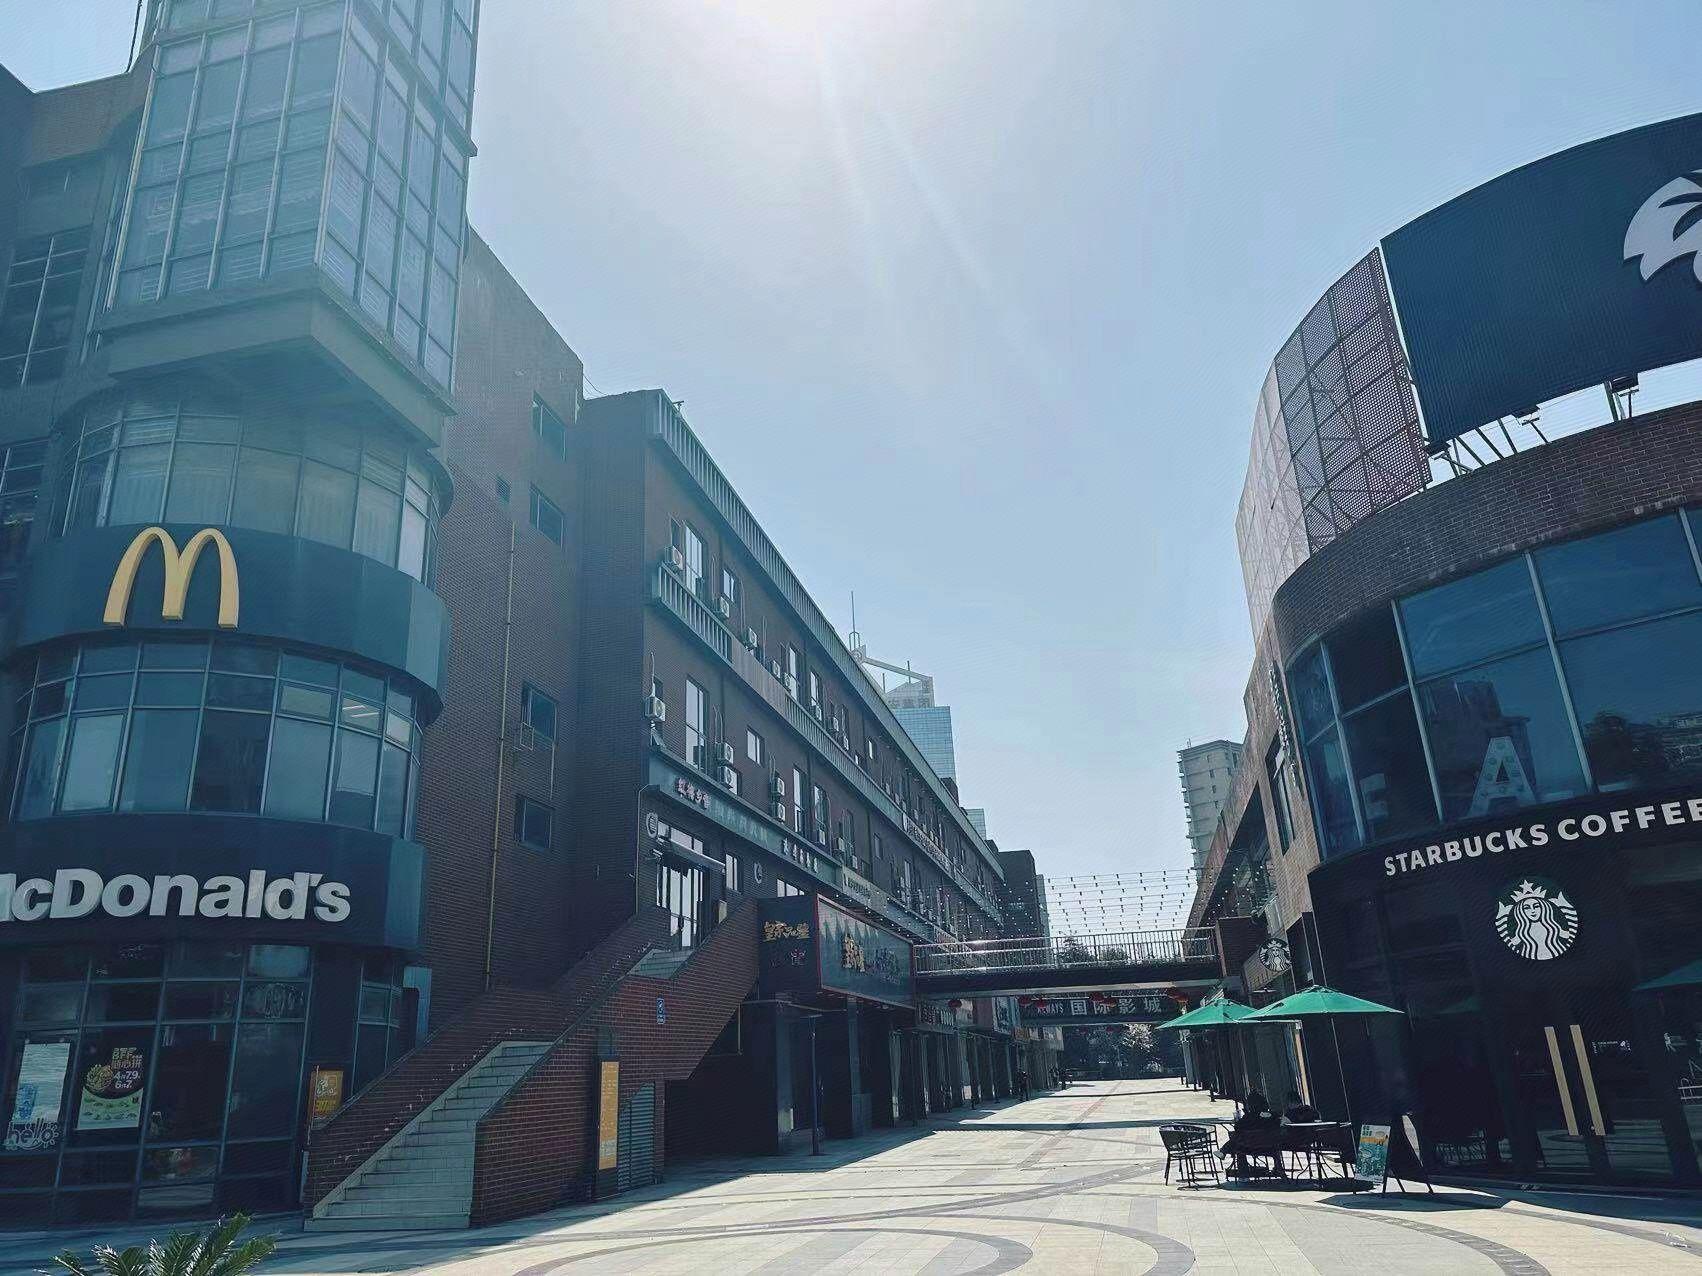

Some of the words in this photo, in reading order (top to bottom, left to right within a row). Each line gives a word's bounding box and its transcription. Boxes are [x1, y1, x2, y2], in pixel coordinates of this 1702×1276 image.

[1383, 823, 1550, 877] STARBUCKS
[1556, 797, 1702, 842] COFFEE
[0, 867, 351, 922] cDonald's
[1070, 997, 1161, 1015] 国际影城
